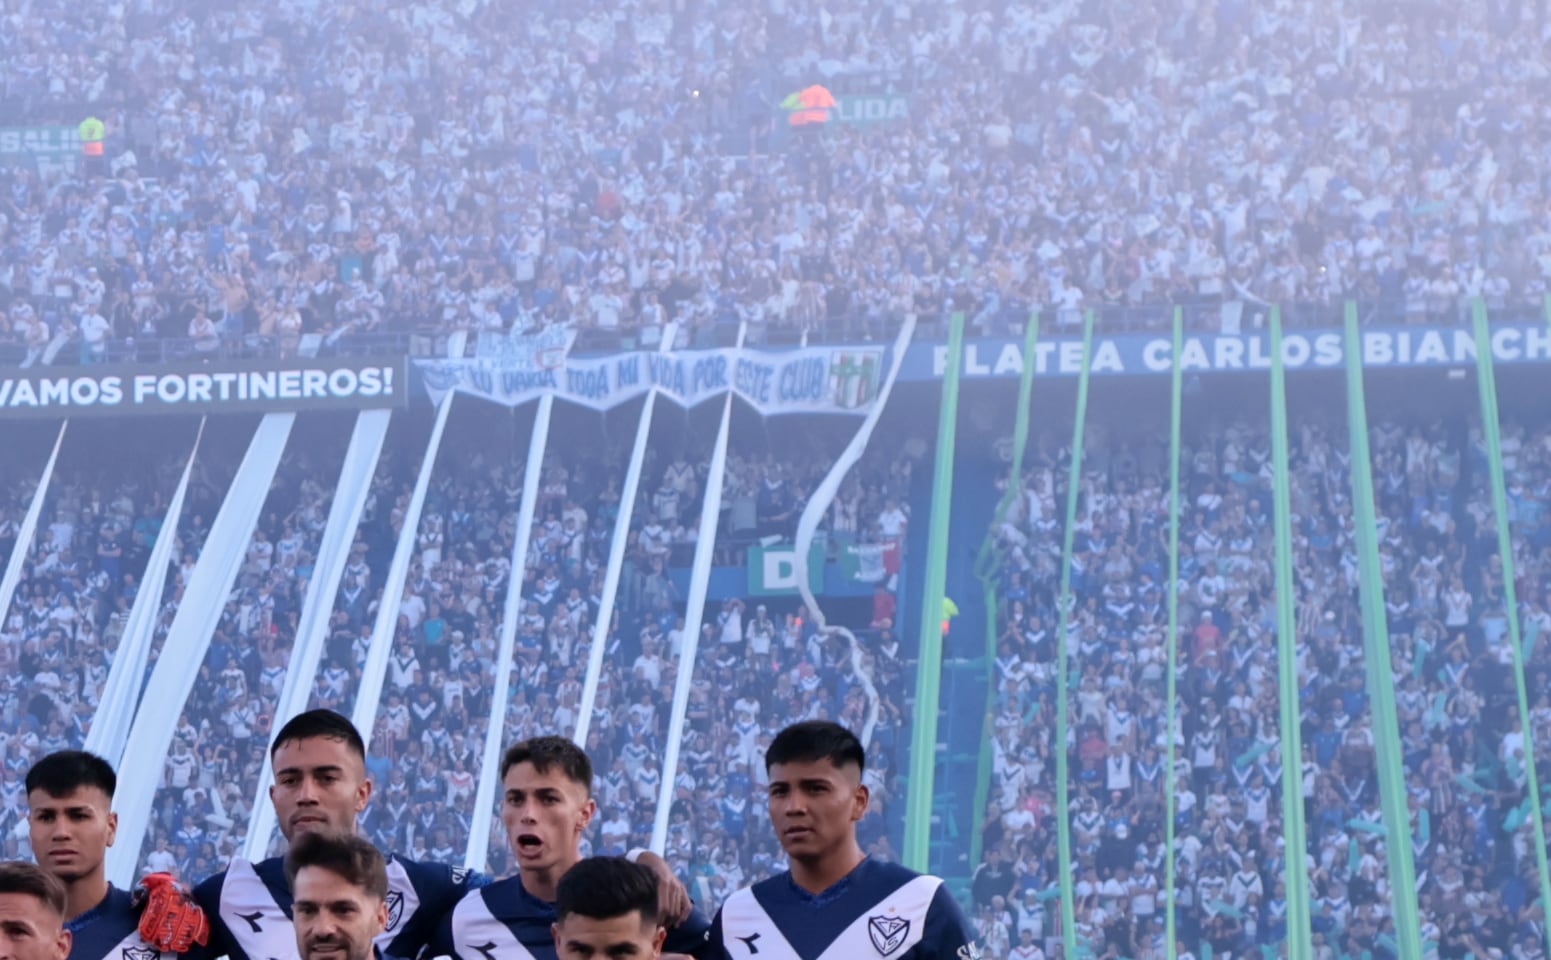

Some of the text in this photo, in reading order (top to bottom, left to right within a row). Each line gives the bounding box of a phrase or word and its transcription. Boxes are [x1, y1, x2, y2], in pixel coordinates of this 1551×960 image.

[1142, 334, 1342, 367] CARLOS
[134, 366, 394, 403] FORTINEROS!
[694, 354, 730, 398] POR
[779, 356, 826, 401] CLUB
